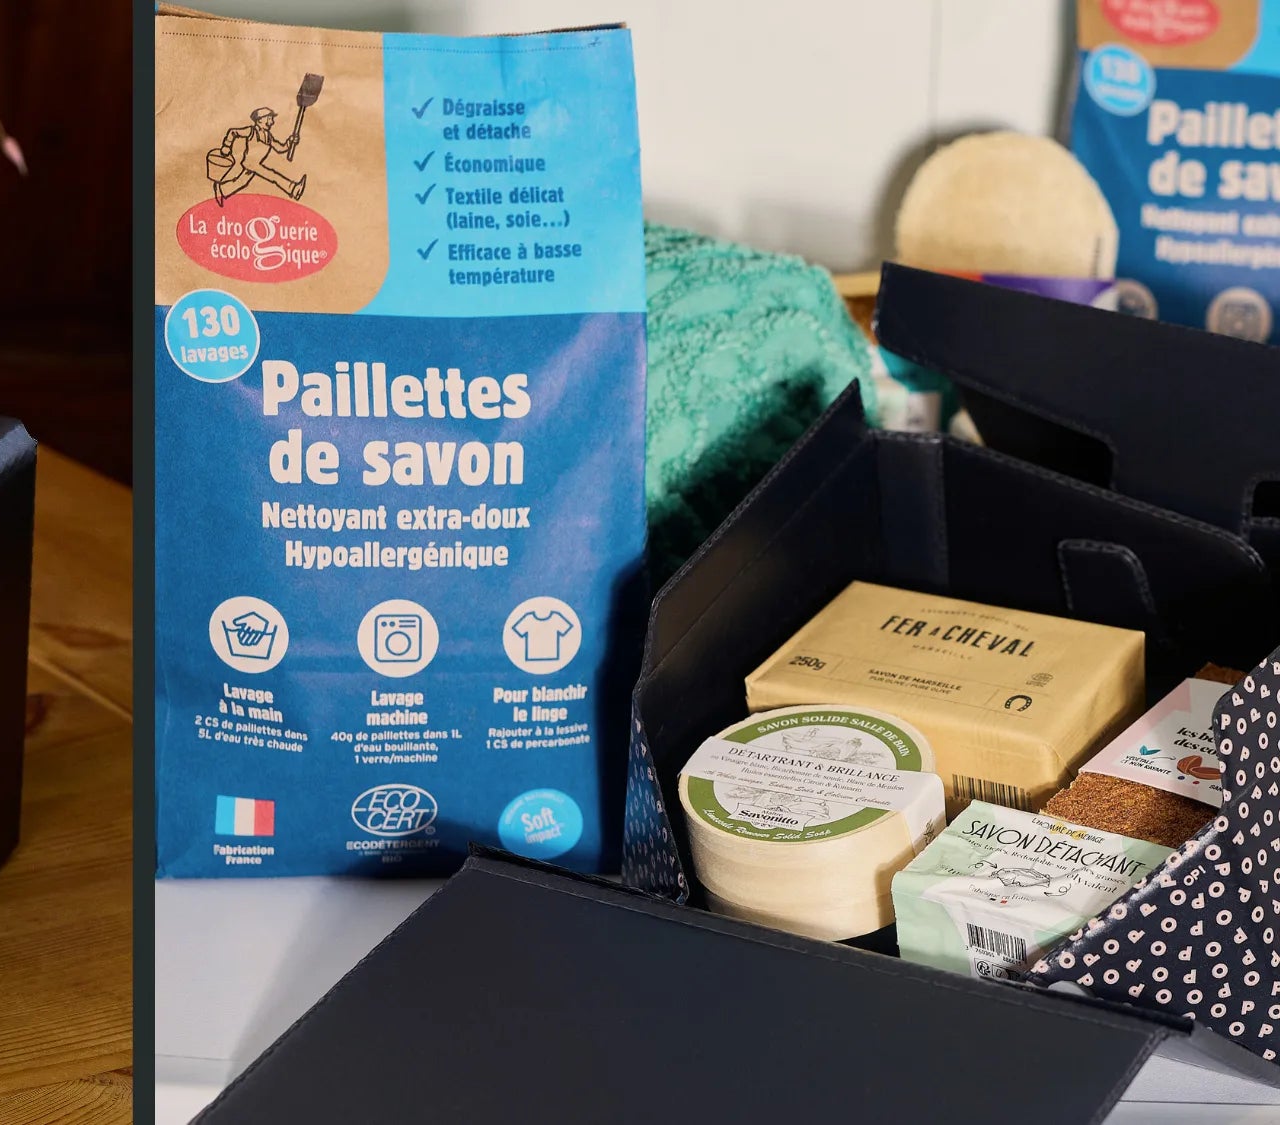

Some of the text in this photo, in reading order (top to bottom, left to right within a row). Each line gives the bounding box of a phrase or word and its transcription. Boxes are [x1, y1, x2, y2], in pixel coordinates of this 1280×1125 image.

[442, 97, 526, 118] Dégraisse
[443, 122, 531, 140] et détache
[444, 152, 546, 174] Économique
[1148, 150, 1208, 198] de
[445, 186, 564, 205] Textile délicat
[190, 214, 207, 235] La
[446, 212, 500, 230] (laine,
[448, 241, 582, 261] Efficace à basse
[449, 267, 555, 287] température
[181, 305, 240, 339] 130
[180, 343, 249, 364] lavages
[261, 360, 531, 419] Paillettes
[269, 428, 524, 486] de savon
[261, 502, 531, 532] Nettoyant extra-doux
[285, 540, 509, 570] Hypoallergénique
[880, 615, 928, 637] FER
[941, 624, 1036, 658] CHEVAL
[789, 655, 827, 671] 250g
[868, 669, 962, 691] SAVON MARSEILLE
[223, 682, 274, 704] Lavage
[371, 690, 424, 707] Lavage
[493, 684, 588, 703] Pour blanchir
[219, 698, 284, 723] à la main
[366, 708, 428, 726] machine
[513, 706, 568, 723] le linge
[195, 714, 308, 741] 2 CS de paillettes dans
[330, 729, 448, 743] 40g de paillettes dans
[488, 727, 533, 738] Rajouter
[544, 726, 554, 736] la
[556, 723, 589, 735] lessive
[757, 715, 910, 757] SAVON SOLIDE SALLE DE BAIN
[198, 728, 303, 752] 5L d'eau très chaude
[354, 742, 382, 753] d'eau
[510, 734, 591, 749] de percarbonate
[361, 753, 438, 764] verre/machine
[828, 765, 900, 783] BRILLANCE
[368, 790, 420, 812] ECO
[367, 809, 430, 830] CERT
[521, 807, 556, 833] Soft
[738, 809, 799, 826] Savonitto
[213, 844, 275, 856] Fabrication
[962, 820, 1035, 850] SAVON
[1034, 837, 1146, 877] DÉTACHANT
[225, 855, 262, 865] France
